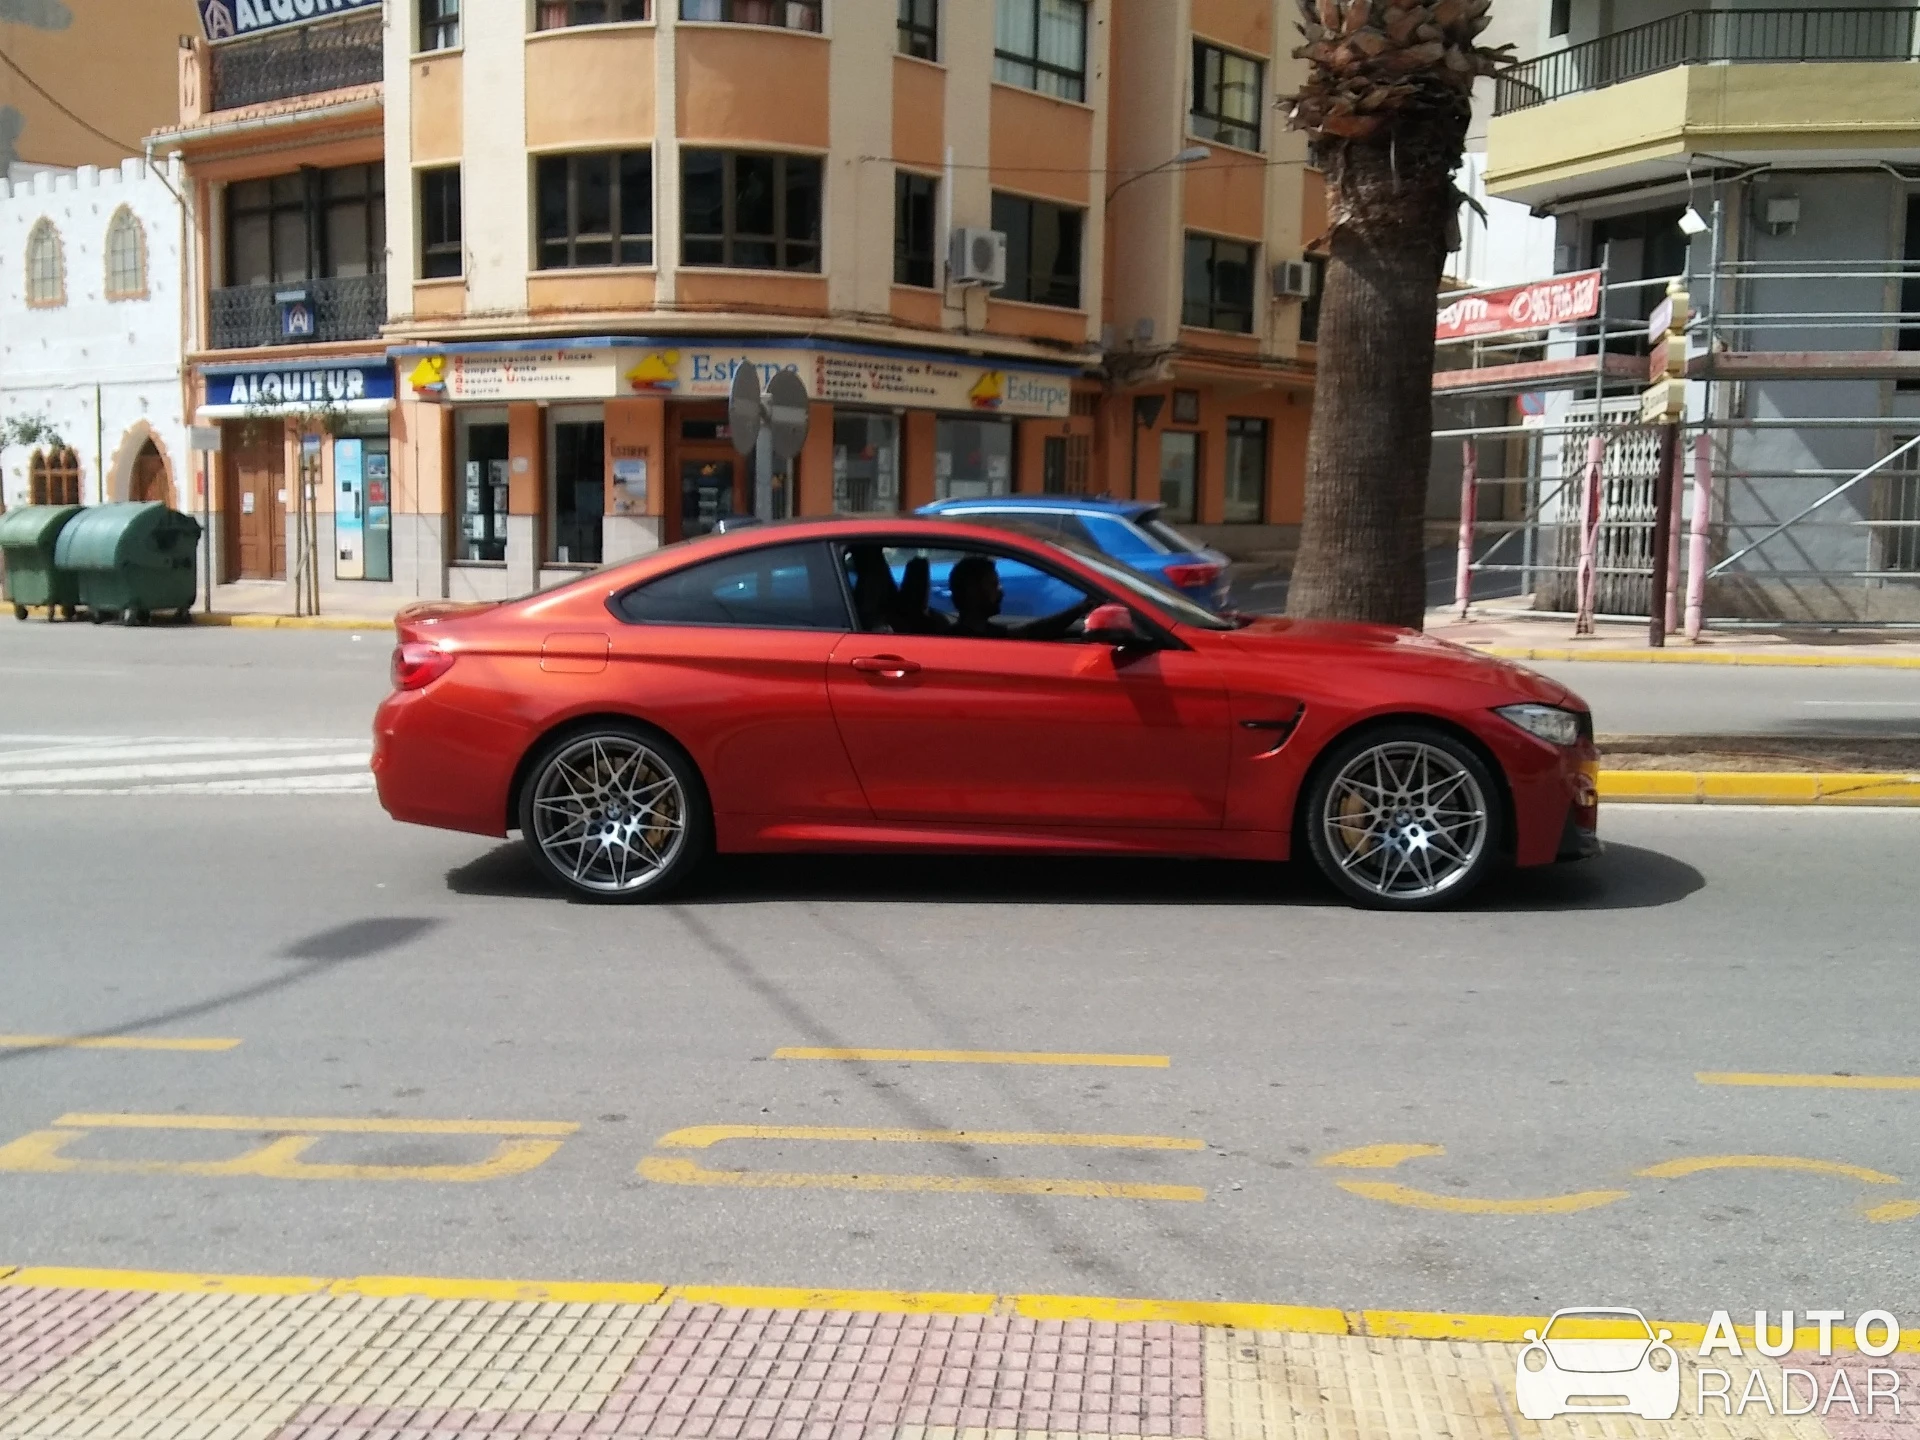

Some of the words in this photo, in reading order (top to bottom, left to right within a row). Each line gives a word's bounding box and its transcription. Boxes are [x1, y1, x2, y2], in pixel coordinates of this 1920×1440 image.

[503, 363, 537, 373] Venta
[539, 354, 553, 362] de
[230, 368, 364, 403] ALQUITUR
[1007, 375, 1067, 412] Estirpe
